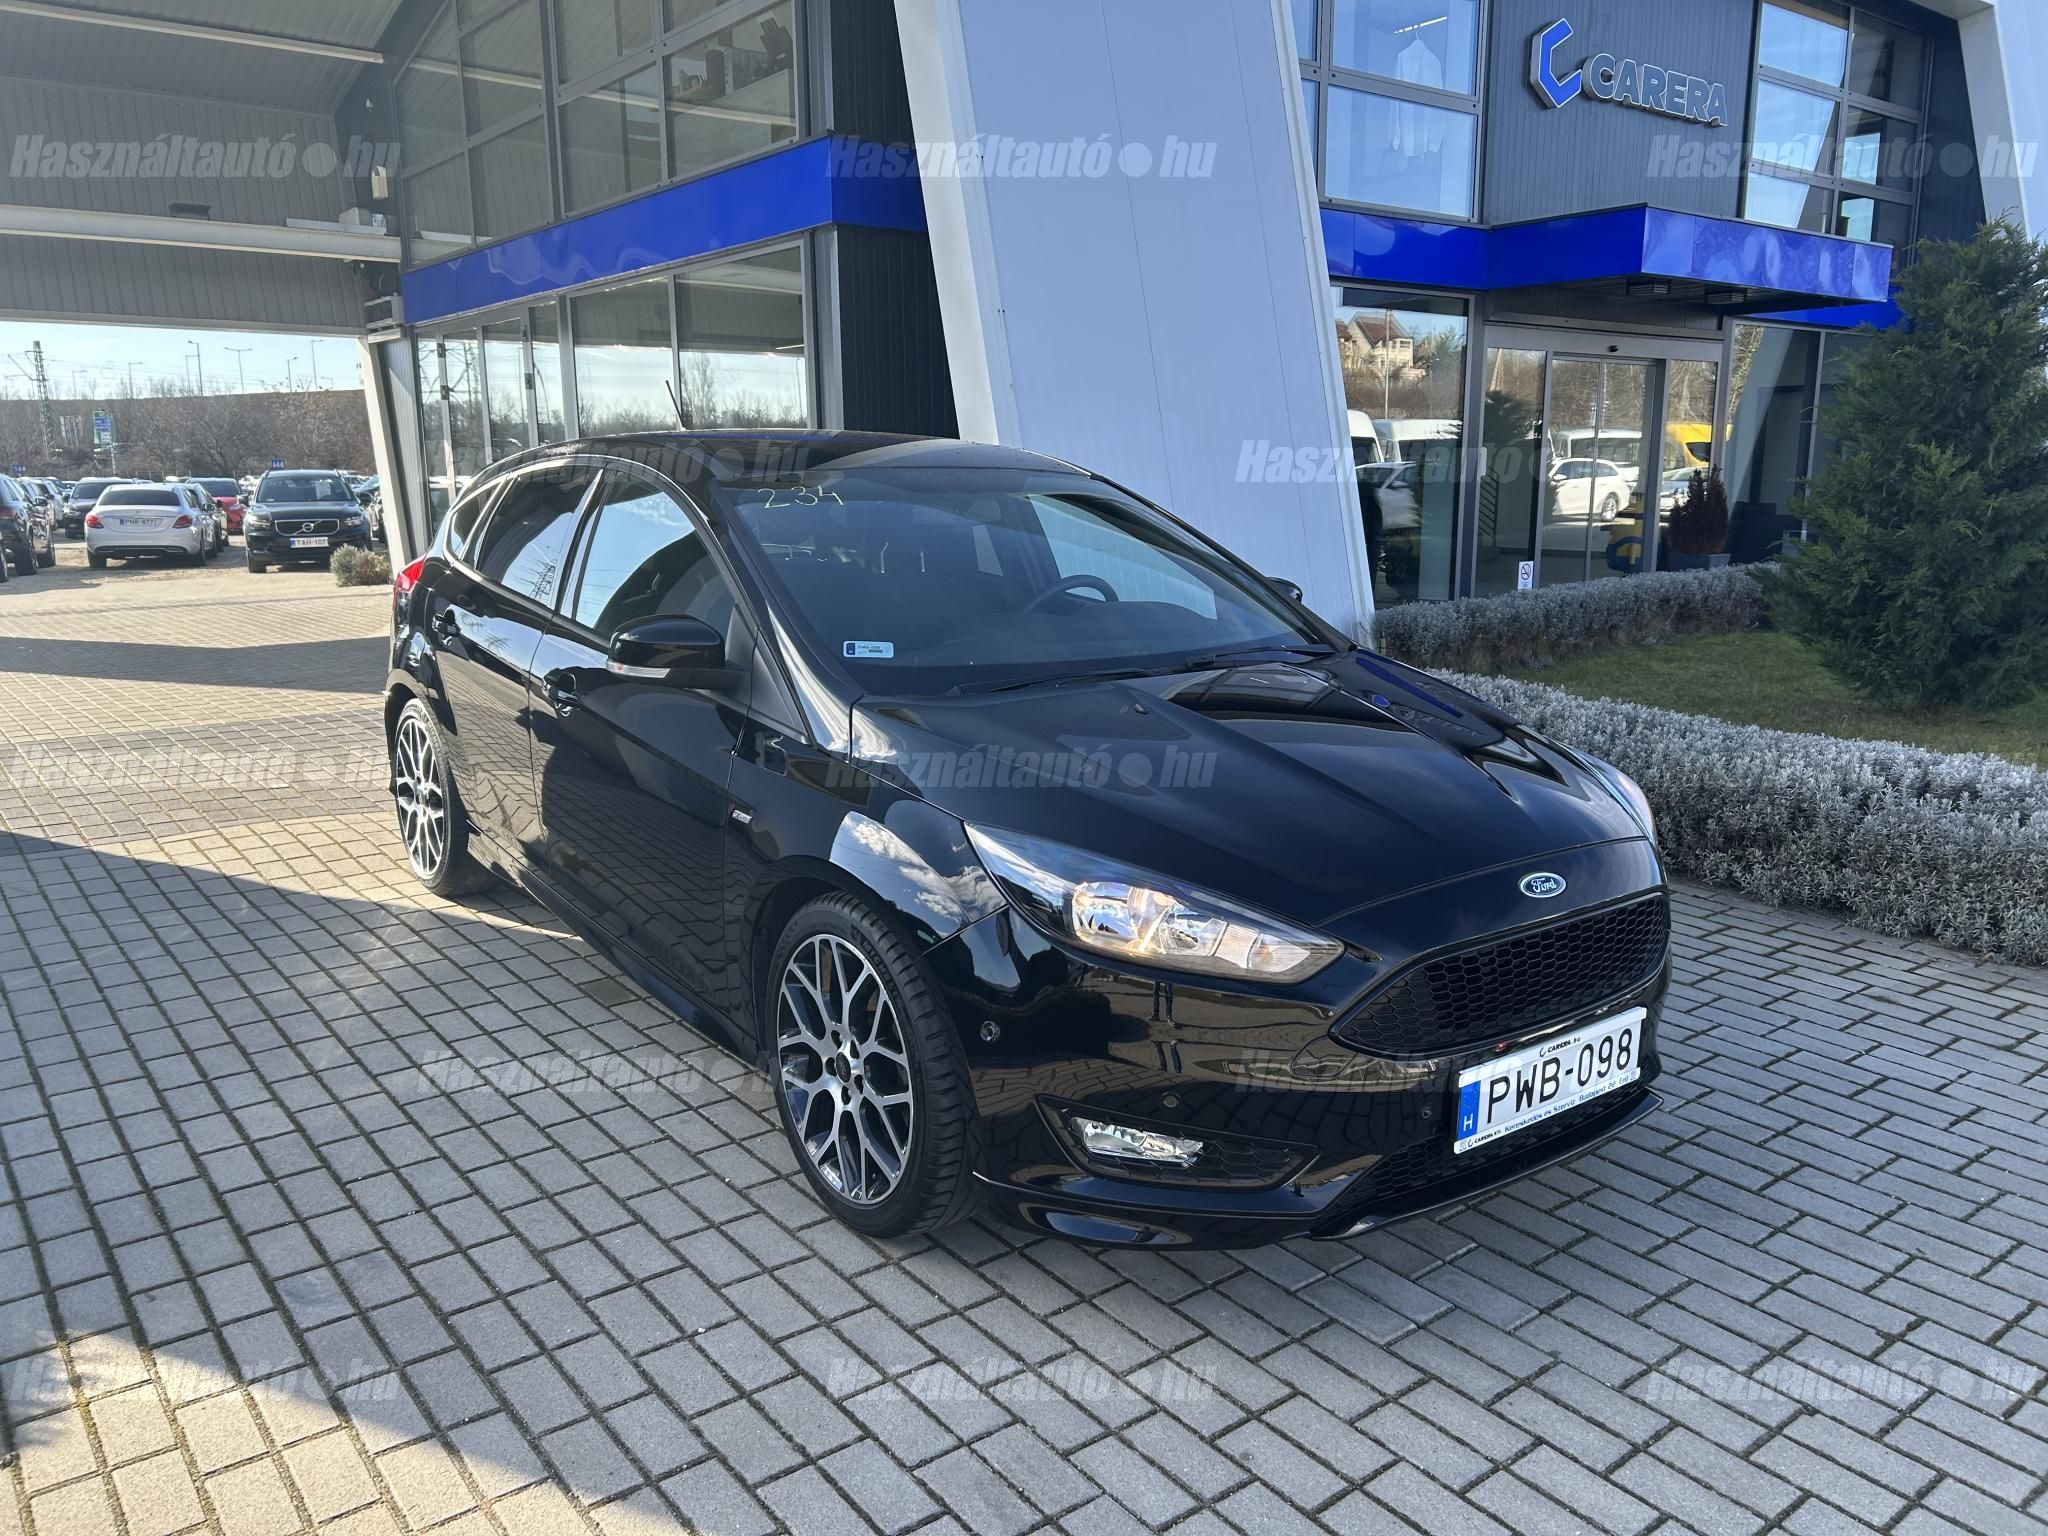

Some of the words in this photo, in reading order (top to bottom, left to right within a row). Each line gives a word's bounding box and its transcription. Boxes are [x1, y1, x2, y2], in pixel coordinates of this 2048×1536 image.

[1583, 53, 1729, 127] CARERA
[757, 485, 845, 508] 234
[1530, 877, 1557, 892] Ford
[1486, 1028, 1633, 1124] PWB-098
[1463, 1113, 1473, 1132] H
